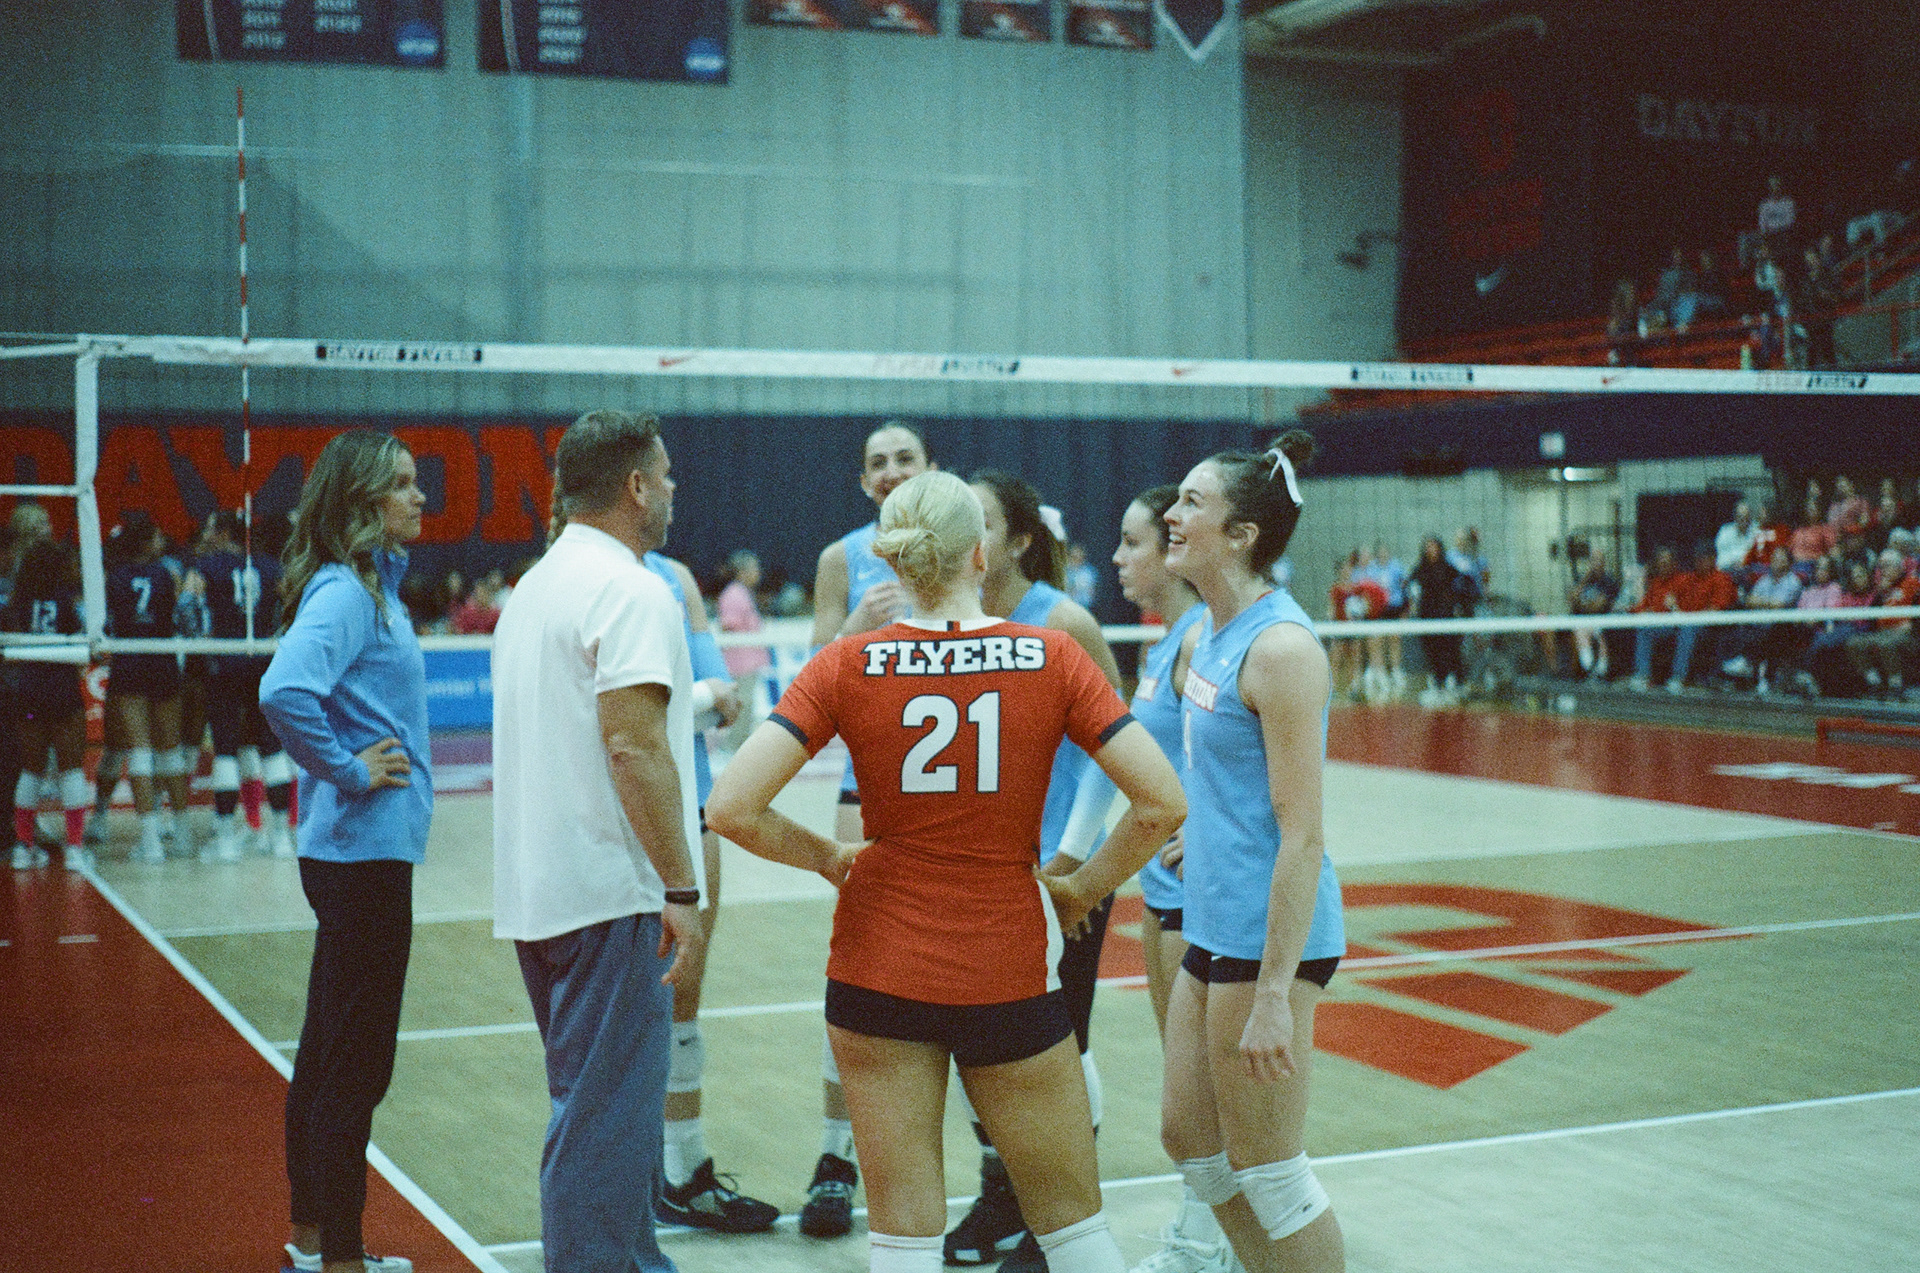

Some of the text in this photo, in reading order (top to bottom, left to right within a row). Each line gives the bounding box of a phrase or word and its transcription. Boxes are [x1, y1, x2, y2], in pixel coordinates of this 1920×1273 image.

[0, 425, 566, 545] DAYON
[131, 576, 152, 615] 7
[861, 636, 1047, 676] FLYERS
[900, 690, 1001, 794] 21
